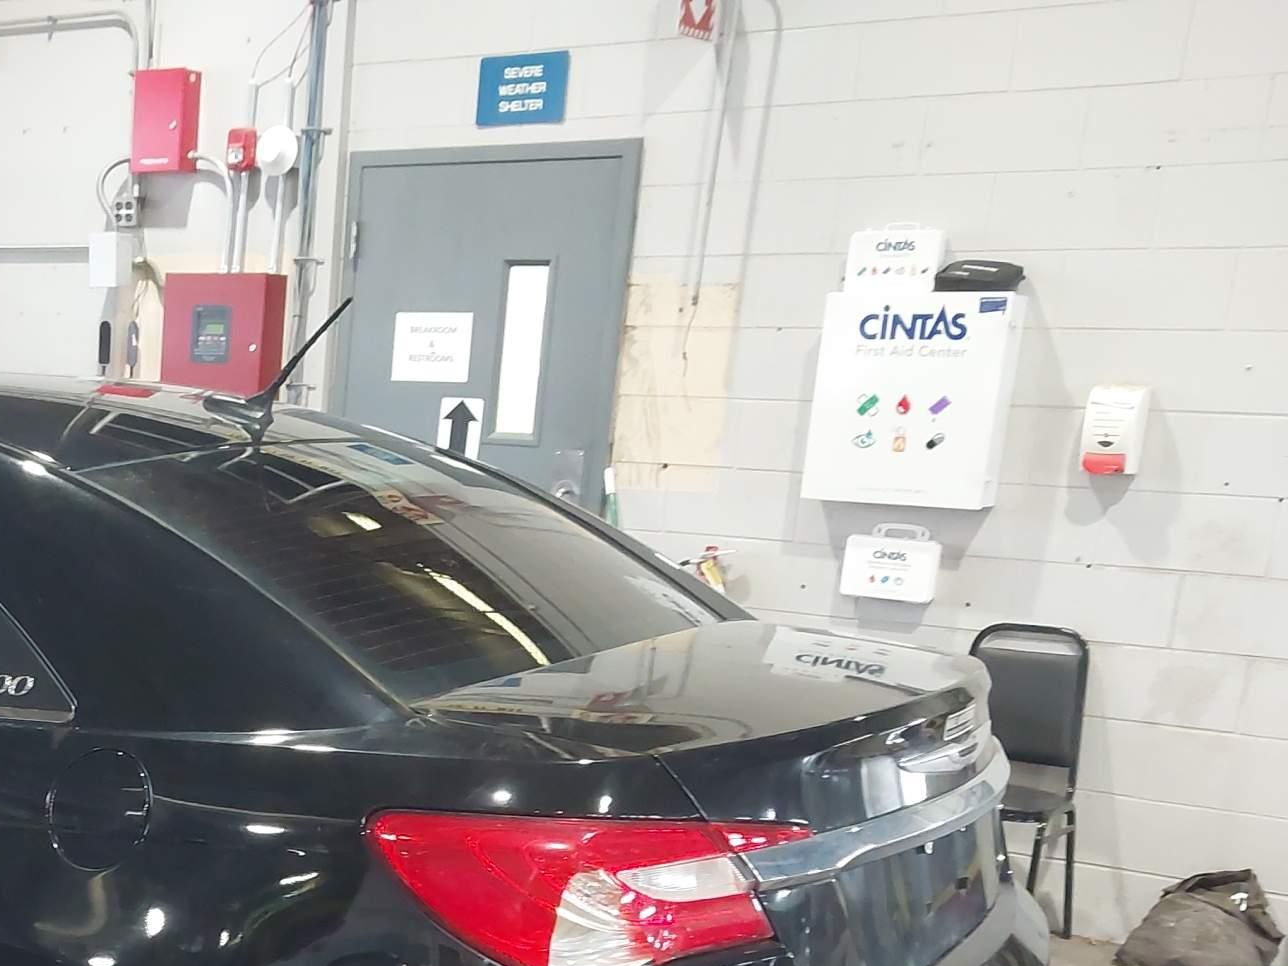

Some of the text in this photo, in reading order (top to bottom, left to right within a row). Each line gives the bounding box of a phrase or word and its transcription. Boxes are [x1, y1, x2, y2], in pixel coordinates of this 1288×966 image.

[503, 64, 545, 79] SEVERE
[498, 81, 547, 97] WEATHER
[498, 98, 544, 113] SHELTER
[855, 344, 968, 358] First Aid Center
